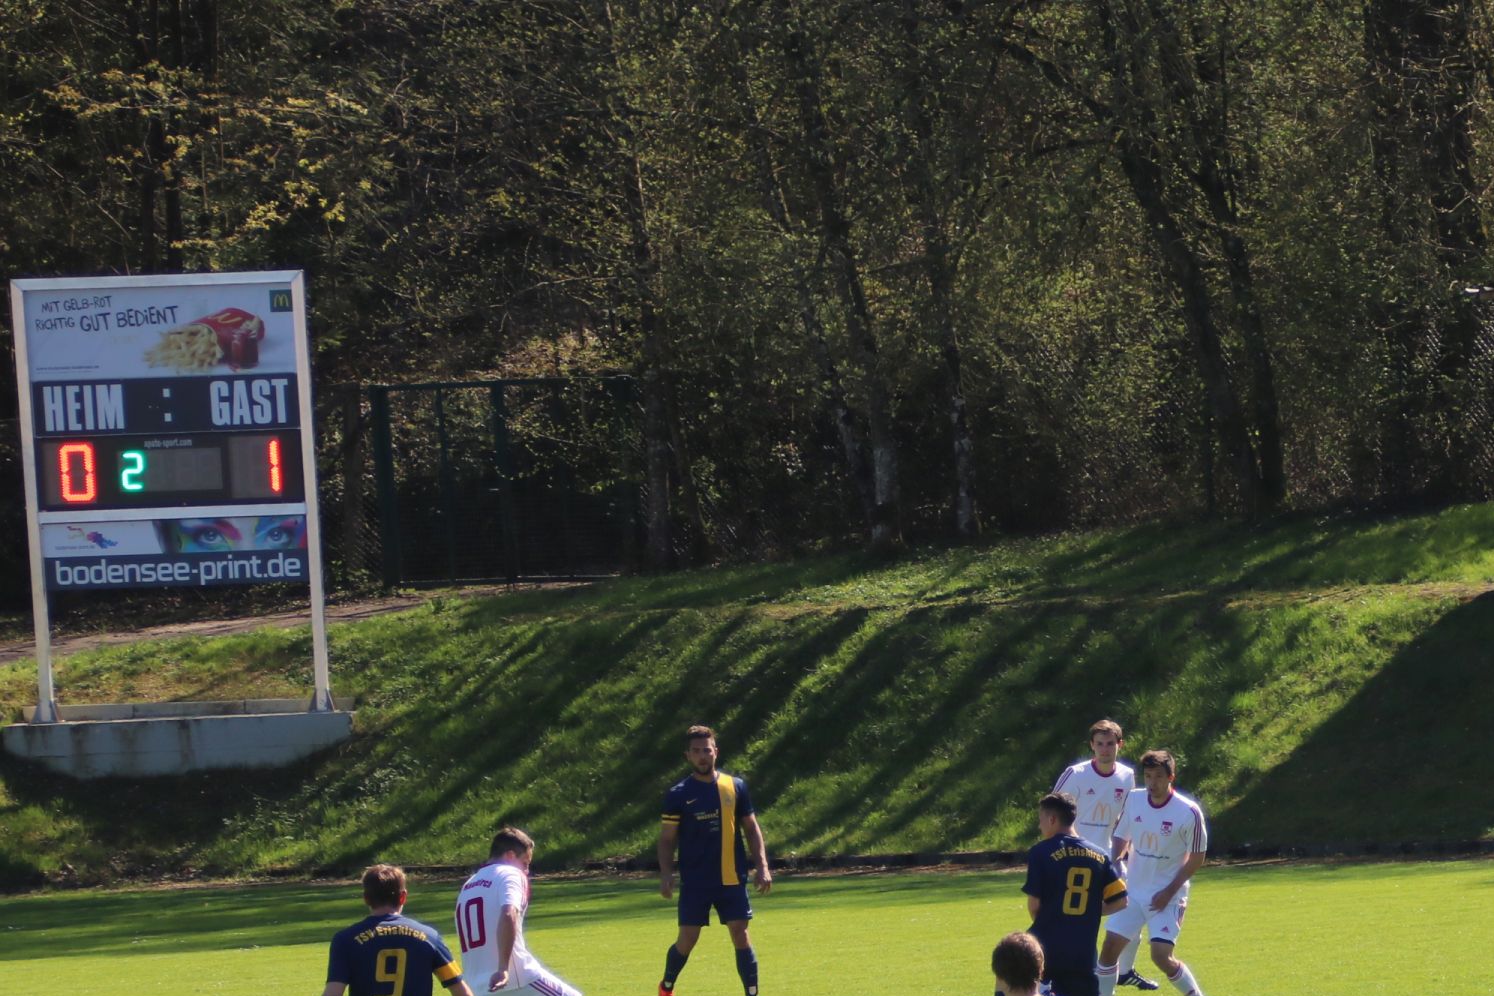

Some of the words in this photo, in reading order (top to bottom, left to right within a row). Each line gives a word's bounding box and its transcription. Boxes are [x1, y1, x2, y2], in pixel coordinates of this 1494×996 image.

[63, 296, 112, 312] GELB-ROT
[80, 312, 111, 332] GUT
[42, 383, 125, 432] HEIM
[210, 378, 288, 426] GAST
[59, 441, 96, 502] 0
[121, 451, 145, 491] 2
[268, 439, 281, 493] 1
[55, 552, 301, 586] bodensee-print.de
[1063, 866, 1092, 915] 8
[456, 896, 486, 953] 10
